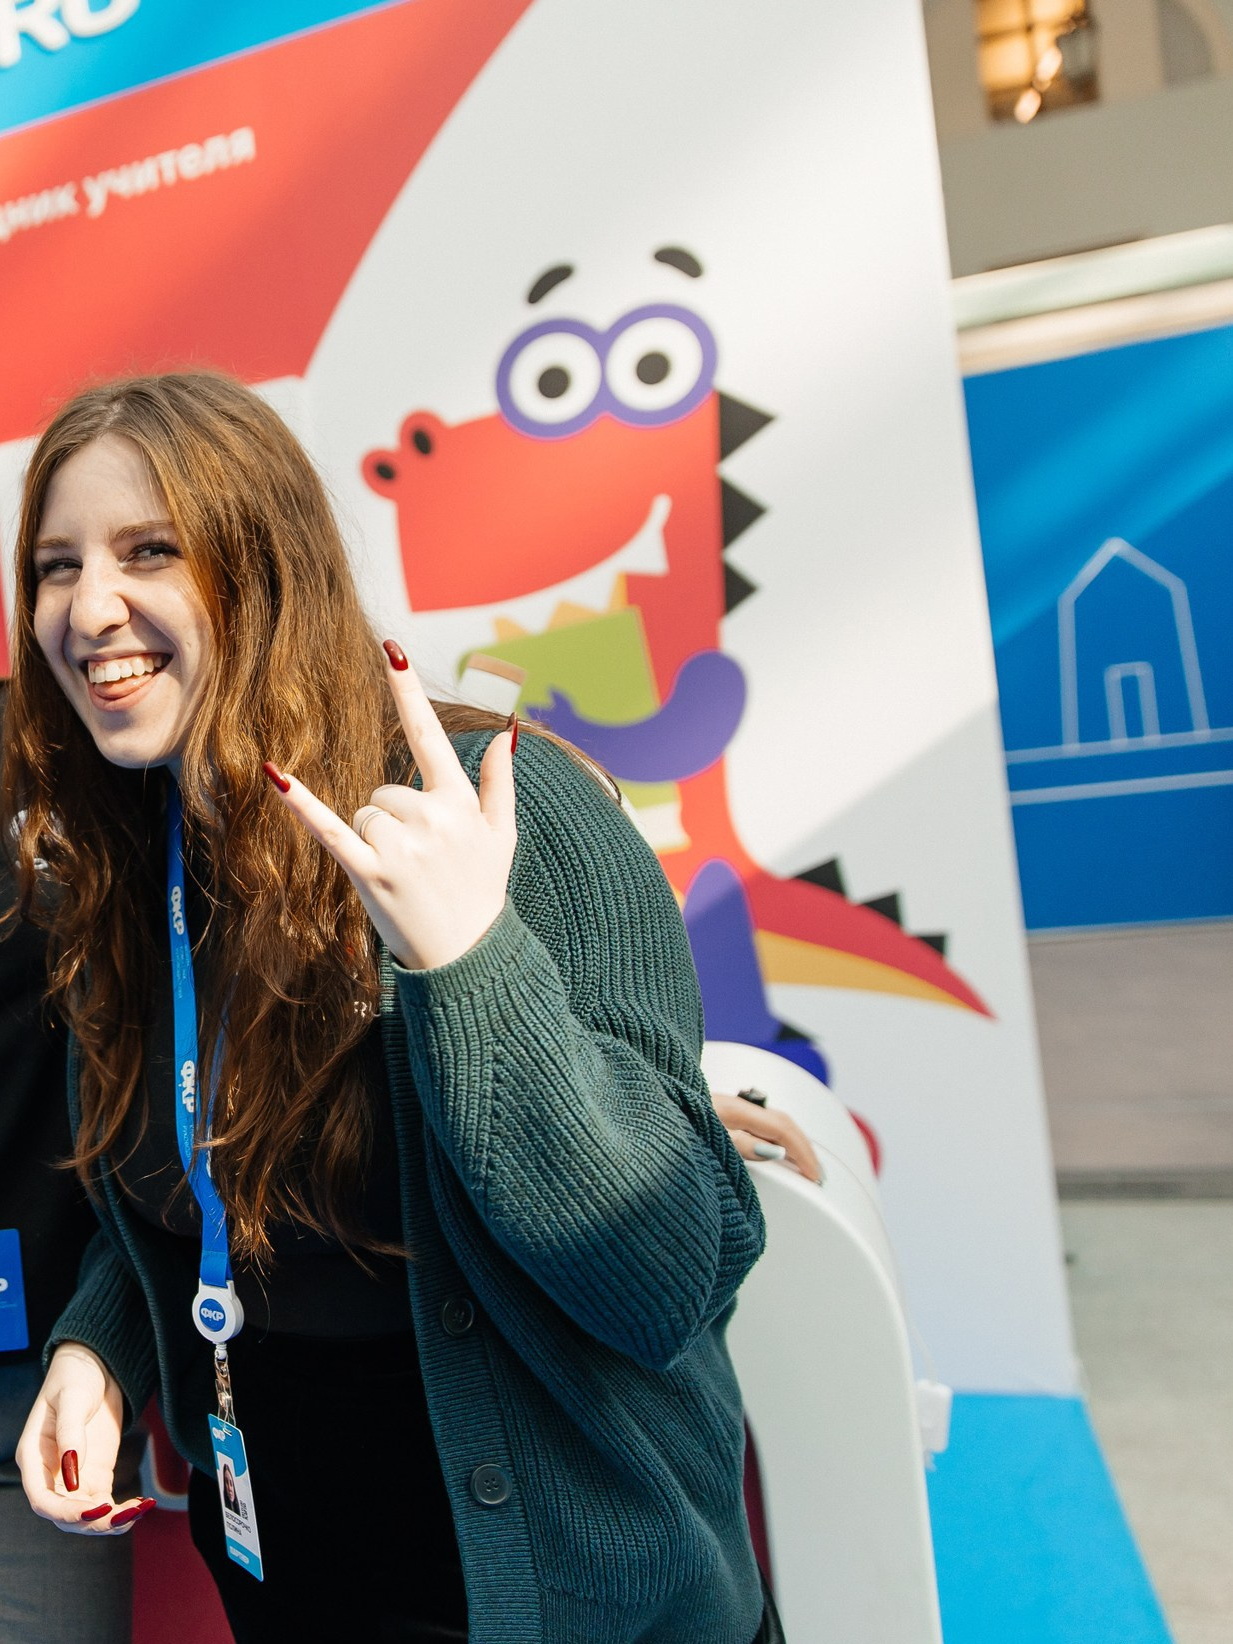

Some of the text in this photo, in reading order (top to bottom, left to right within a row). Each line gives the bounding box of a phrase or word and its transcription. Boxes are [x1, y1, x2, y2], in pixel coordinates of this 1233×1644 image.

[82, 126, 257, 218] учителя
[171, 886, 185, 935] ФКР
[181, 1060, 195, 1113] ФКР
[200, 1307, 225, 1322] ФКР
